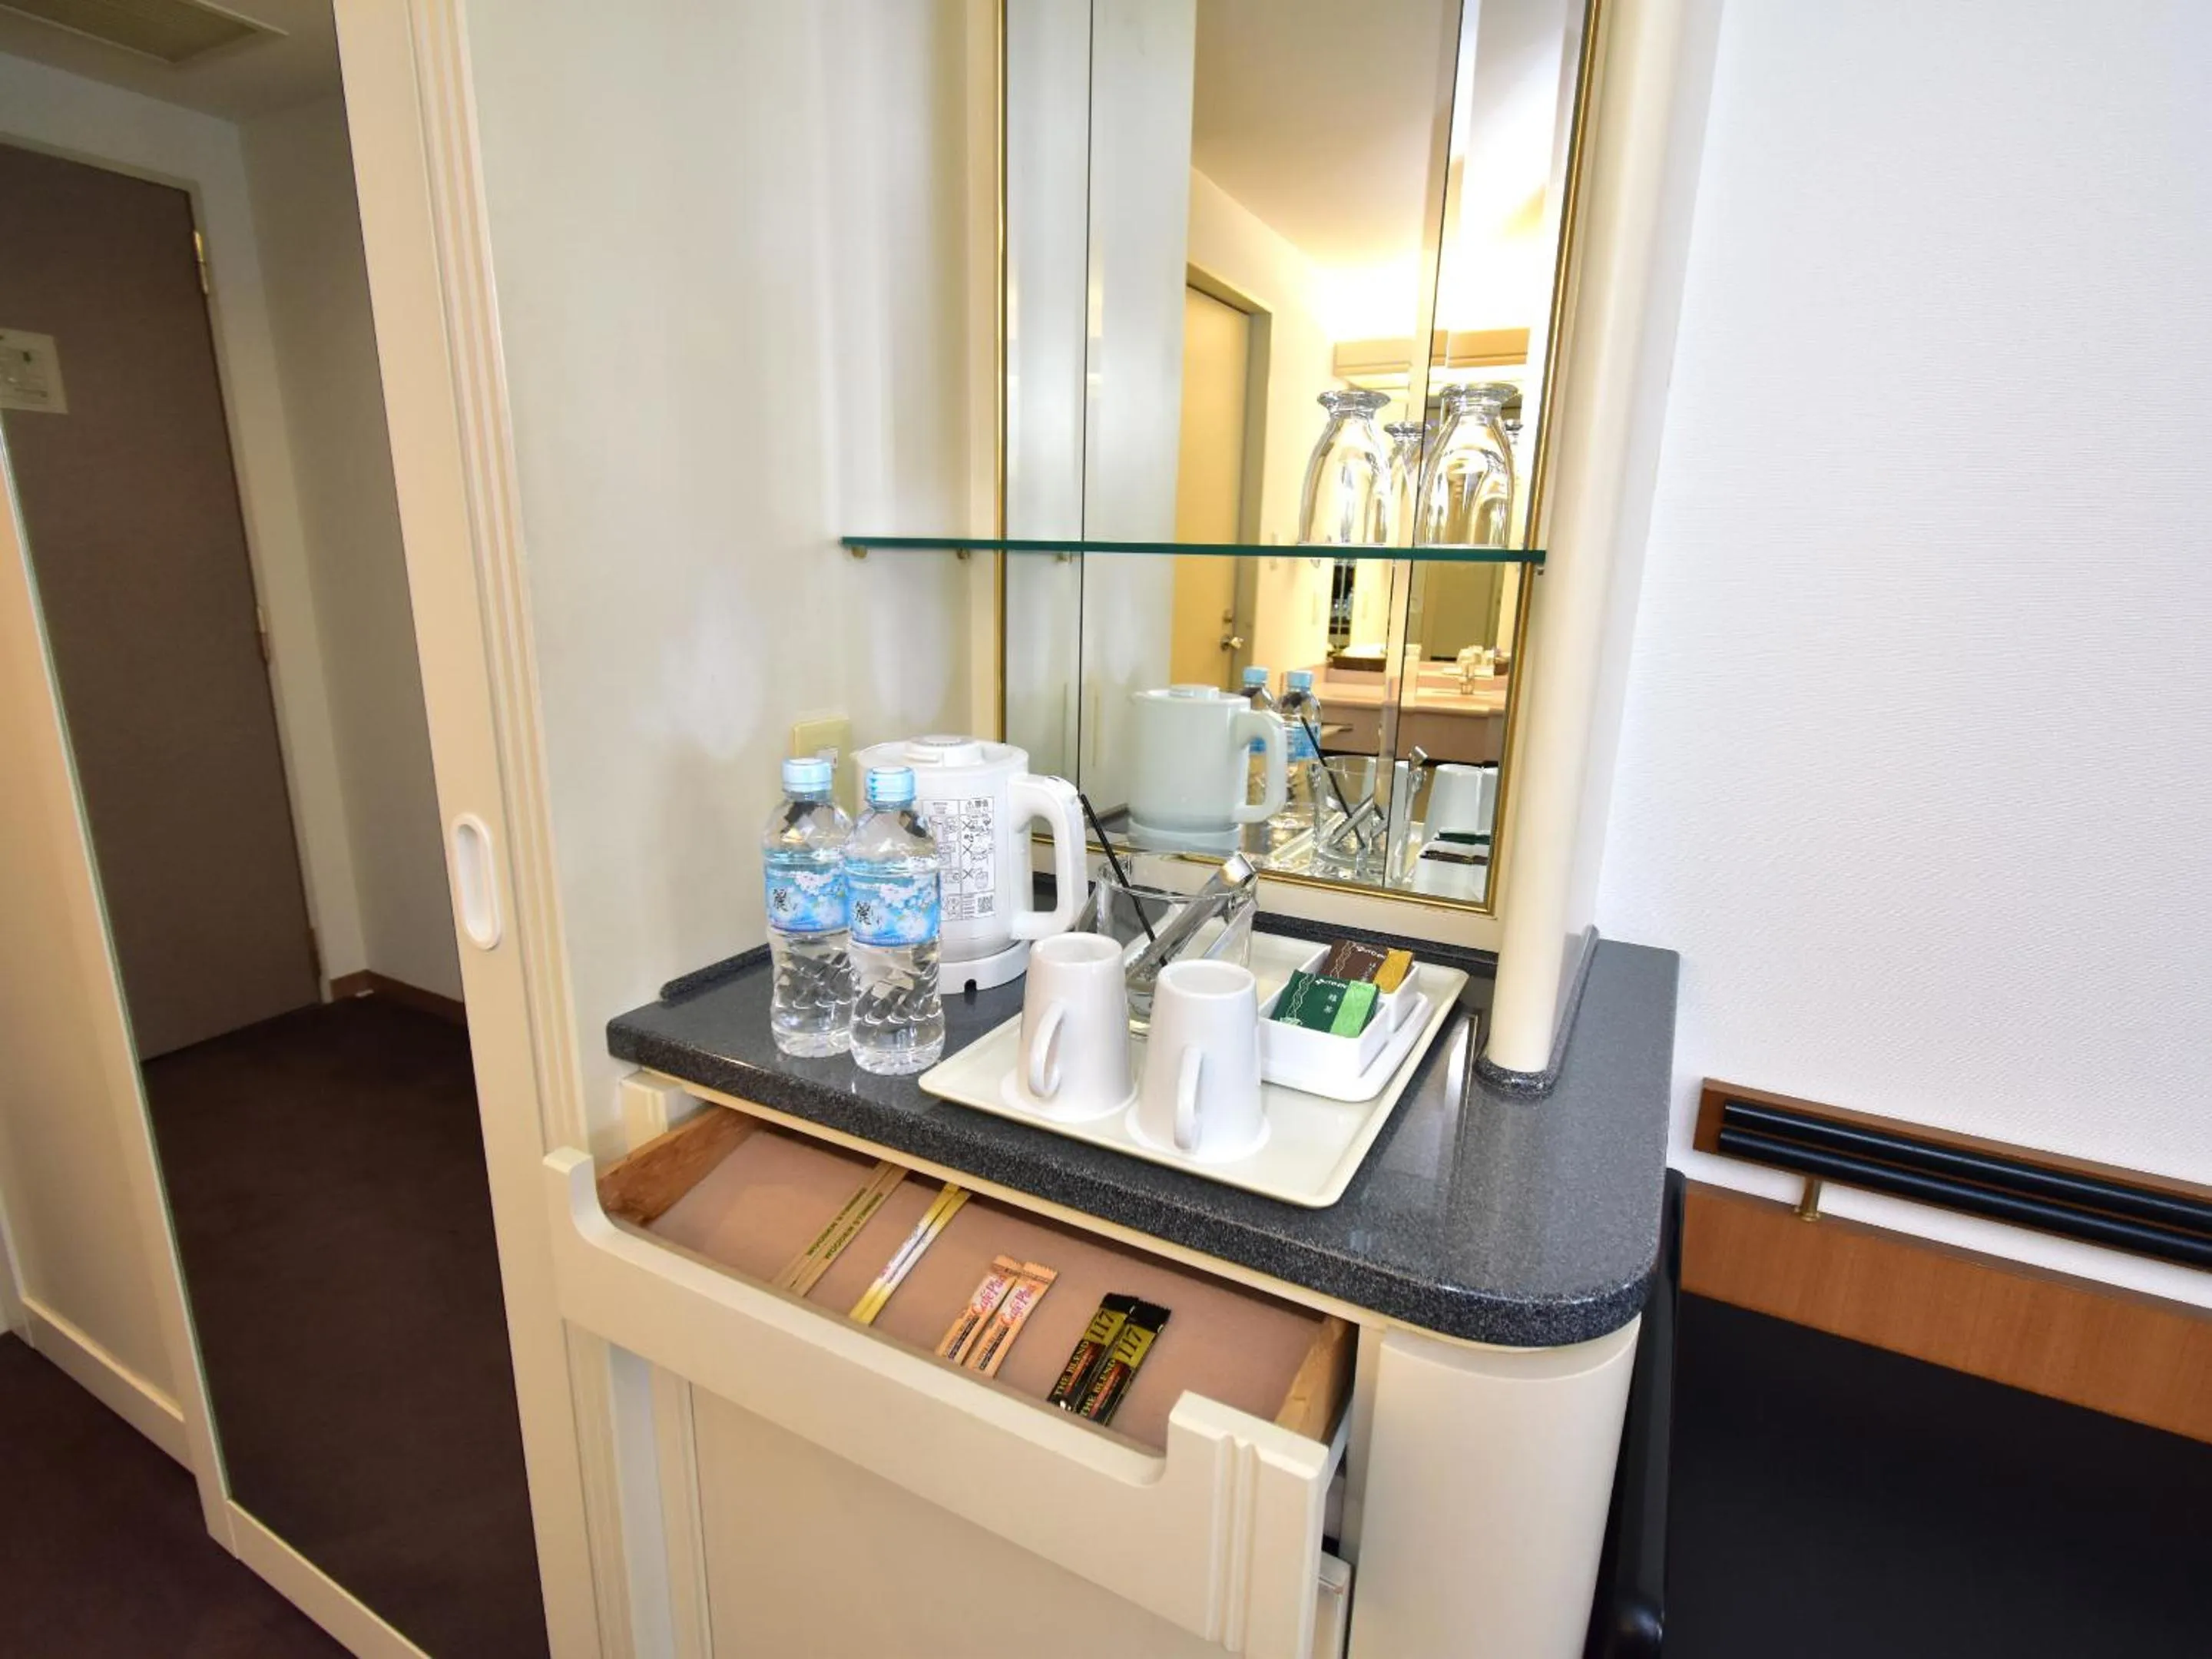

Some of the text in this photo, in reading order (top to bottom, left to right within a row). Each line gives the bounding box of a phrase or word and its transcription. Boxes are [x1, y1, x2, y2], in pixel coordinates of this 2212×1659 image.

[1090, 1310, 1114, 1339] 117
[1117, 1326, 1143, 1359] 117
[1053, 1376, 1069, 1396] THE
[1066, 1340, 1089, 1373] BLEND
[1079, 1394, 1095, 1416] THE
[1093, 1359, 1116, 1393] BLEND
